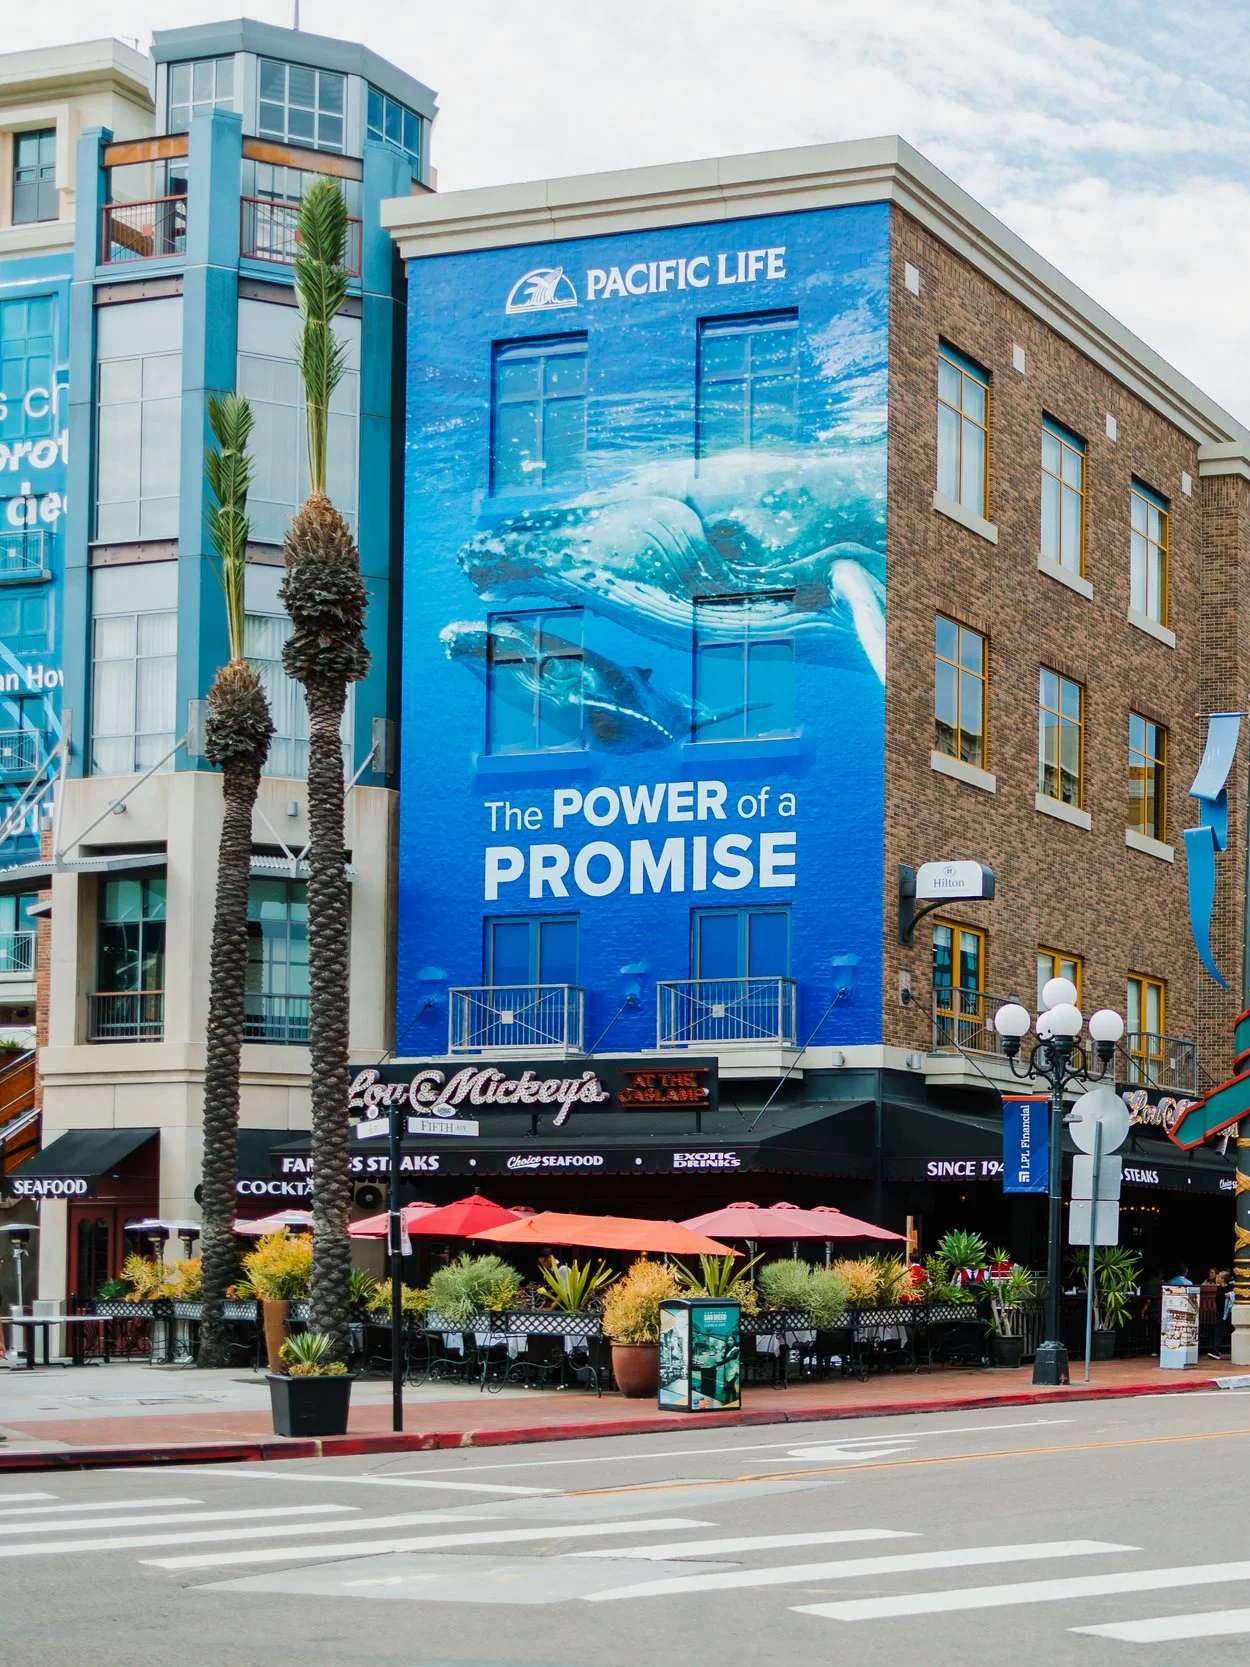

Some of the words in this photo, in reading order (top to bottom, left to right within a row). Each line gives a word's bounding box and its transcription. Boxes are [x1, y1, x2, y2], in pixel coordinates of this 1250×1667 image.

[586, 256, 710, 300] PACIFIC
[717, 247, 787, 285] LIFE
[7, 481, 68, 526] de
[484, 801, 542, 832] The
[553, 780, 728, 829] POWER
[737, 786, 771, 818] of
[778, 792, 796, 817] a
[484, 831, 797, 900] PROMISE
[933, 878, 965, 888] Hilton
[632, 1073, 655, 1087] AT
[661, 1072, 697, 1088] THE
[438, 1066, 611, 1126] Mickey's
[617, 1087, 706, 1102] GASLAMP
[421, 1120, 453, 1132] FIFTH
[1020, 1104, 1030, 1148] Financial
[366, 1155, 440, 1171] STAKS
[507, 1156, 542, 1169] Choice
[542, 1155, 604, 1167] SEAFOOD
[673, 1152, 737, 1161] EXOTIC
[673, 1159, 742, 1168] DRINKS
[1020, 1150, 1030, 1169] LPL
[927, 1161, 977, 1176] SINCE
[1124, 1167, 1159, 1184] STEAKS
[13, 1180, 88, 1195] SEAFOOD
[236, 1180, 315, 1196] COCKTA
